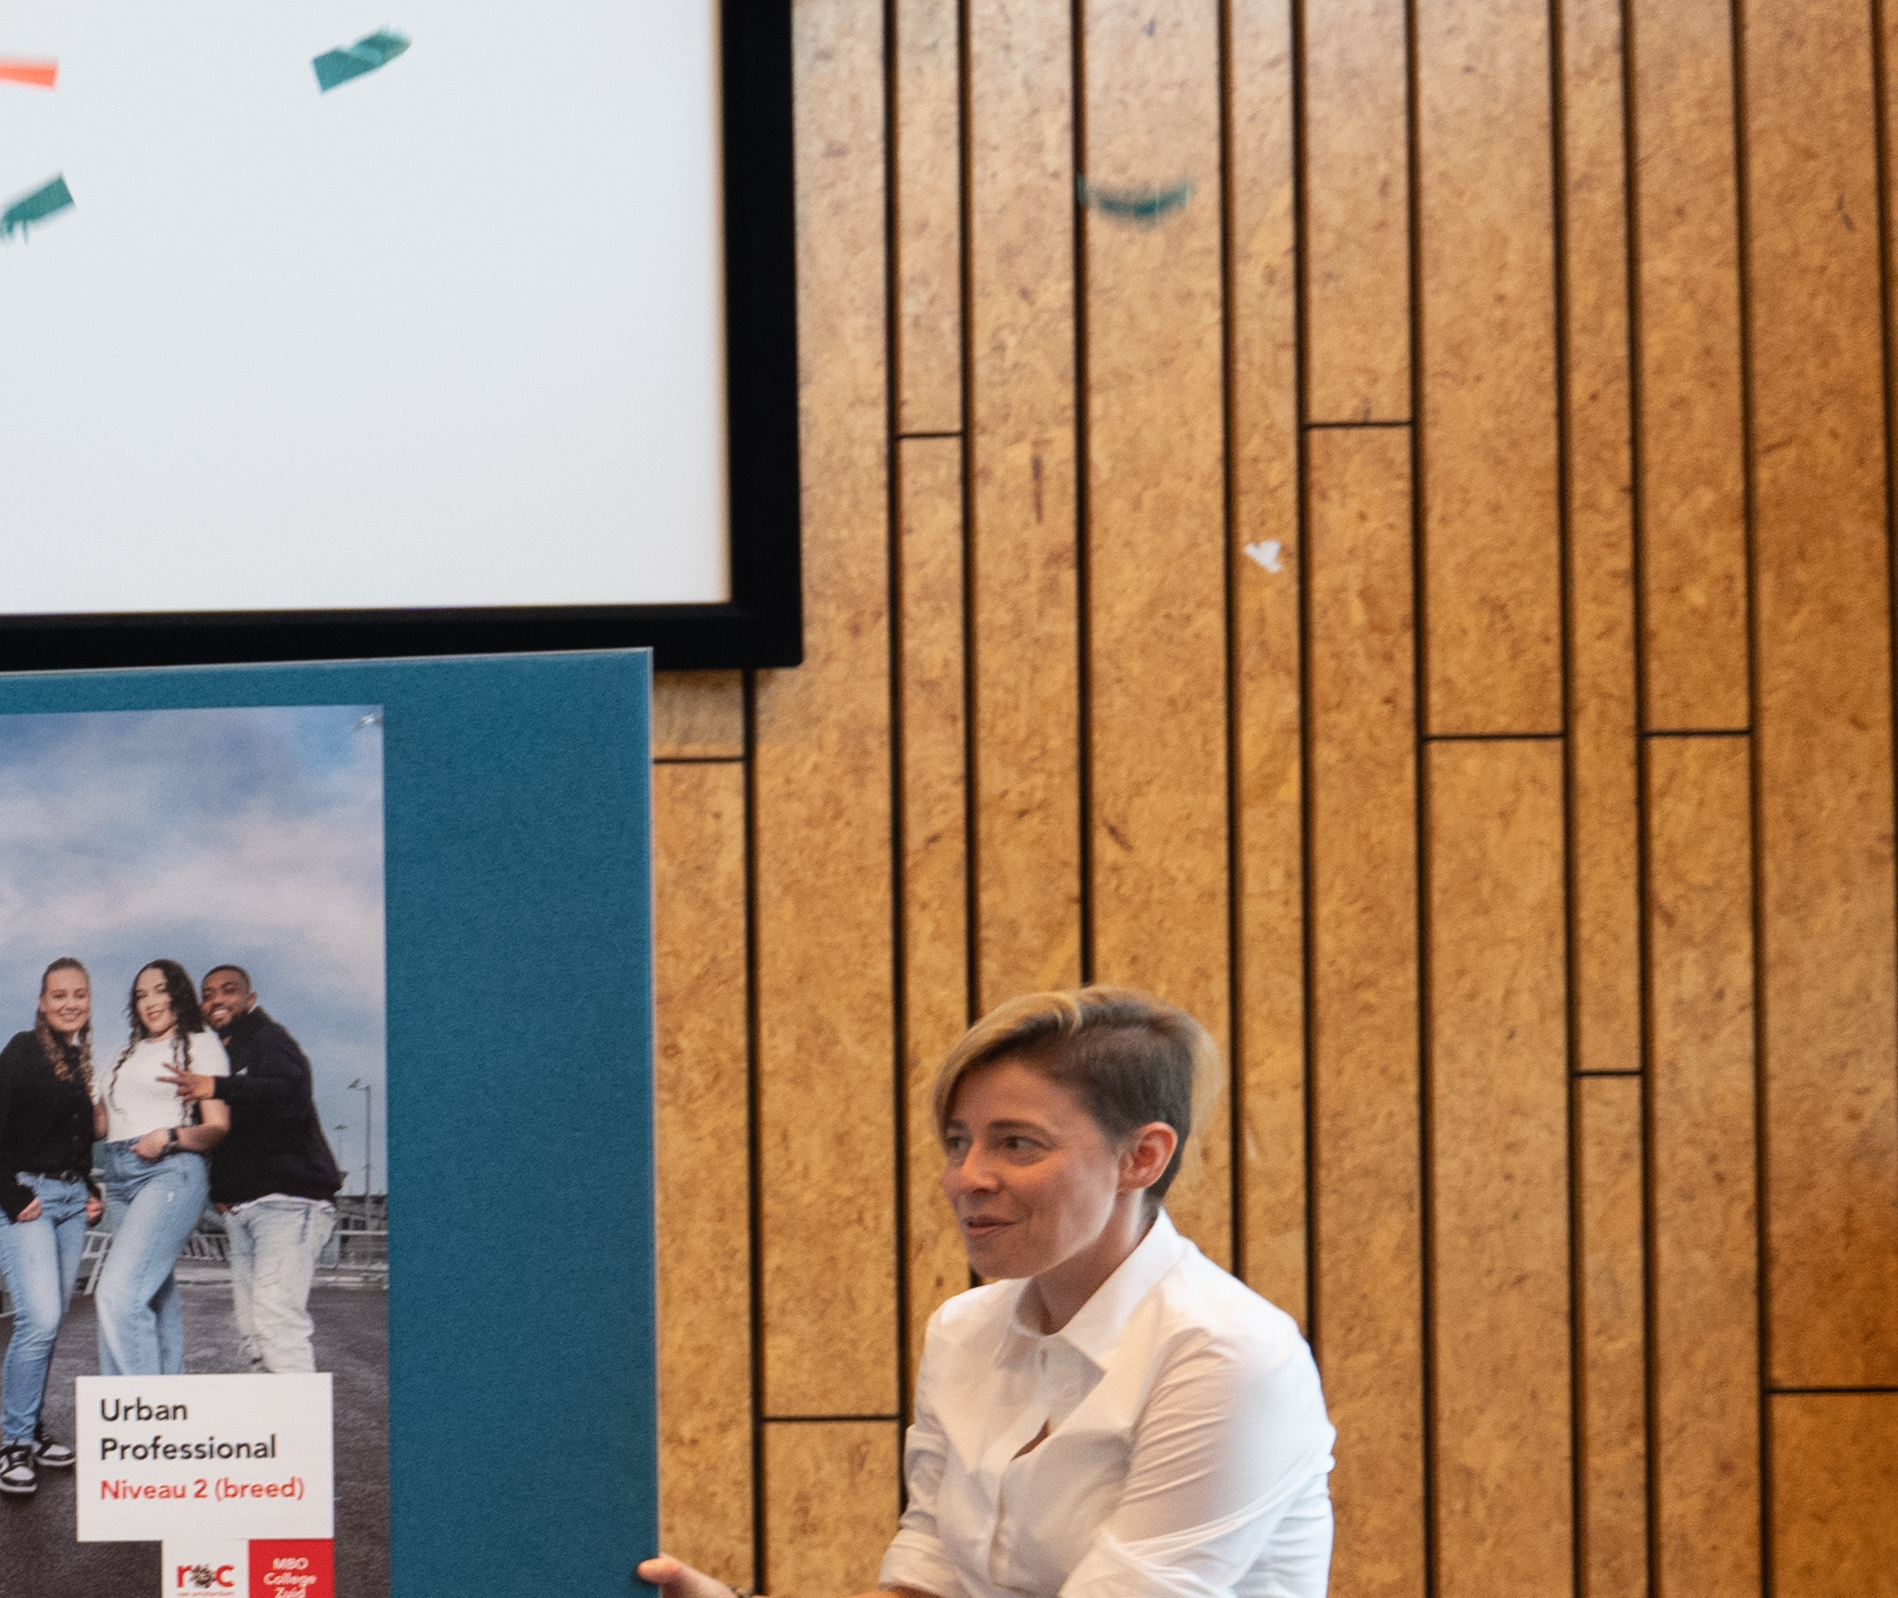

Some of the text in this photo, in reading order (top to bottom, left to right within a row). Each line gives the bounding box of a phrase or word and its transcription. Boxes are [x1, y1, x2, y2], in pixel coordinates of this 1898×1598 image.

[101, 1397, 187, 1422] Urban
[101, 1434, 275, 1460] Professional
[101, 1477, 304, 1501] Niveau 2 (breed)
[273, 1558, 309, 1570] MBO
[263, 1571, 317, 1589] College
